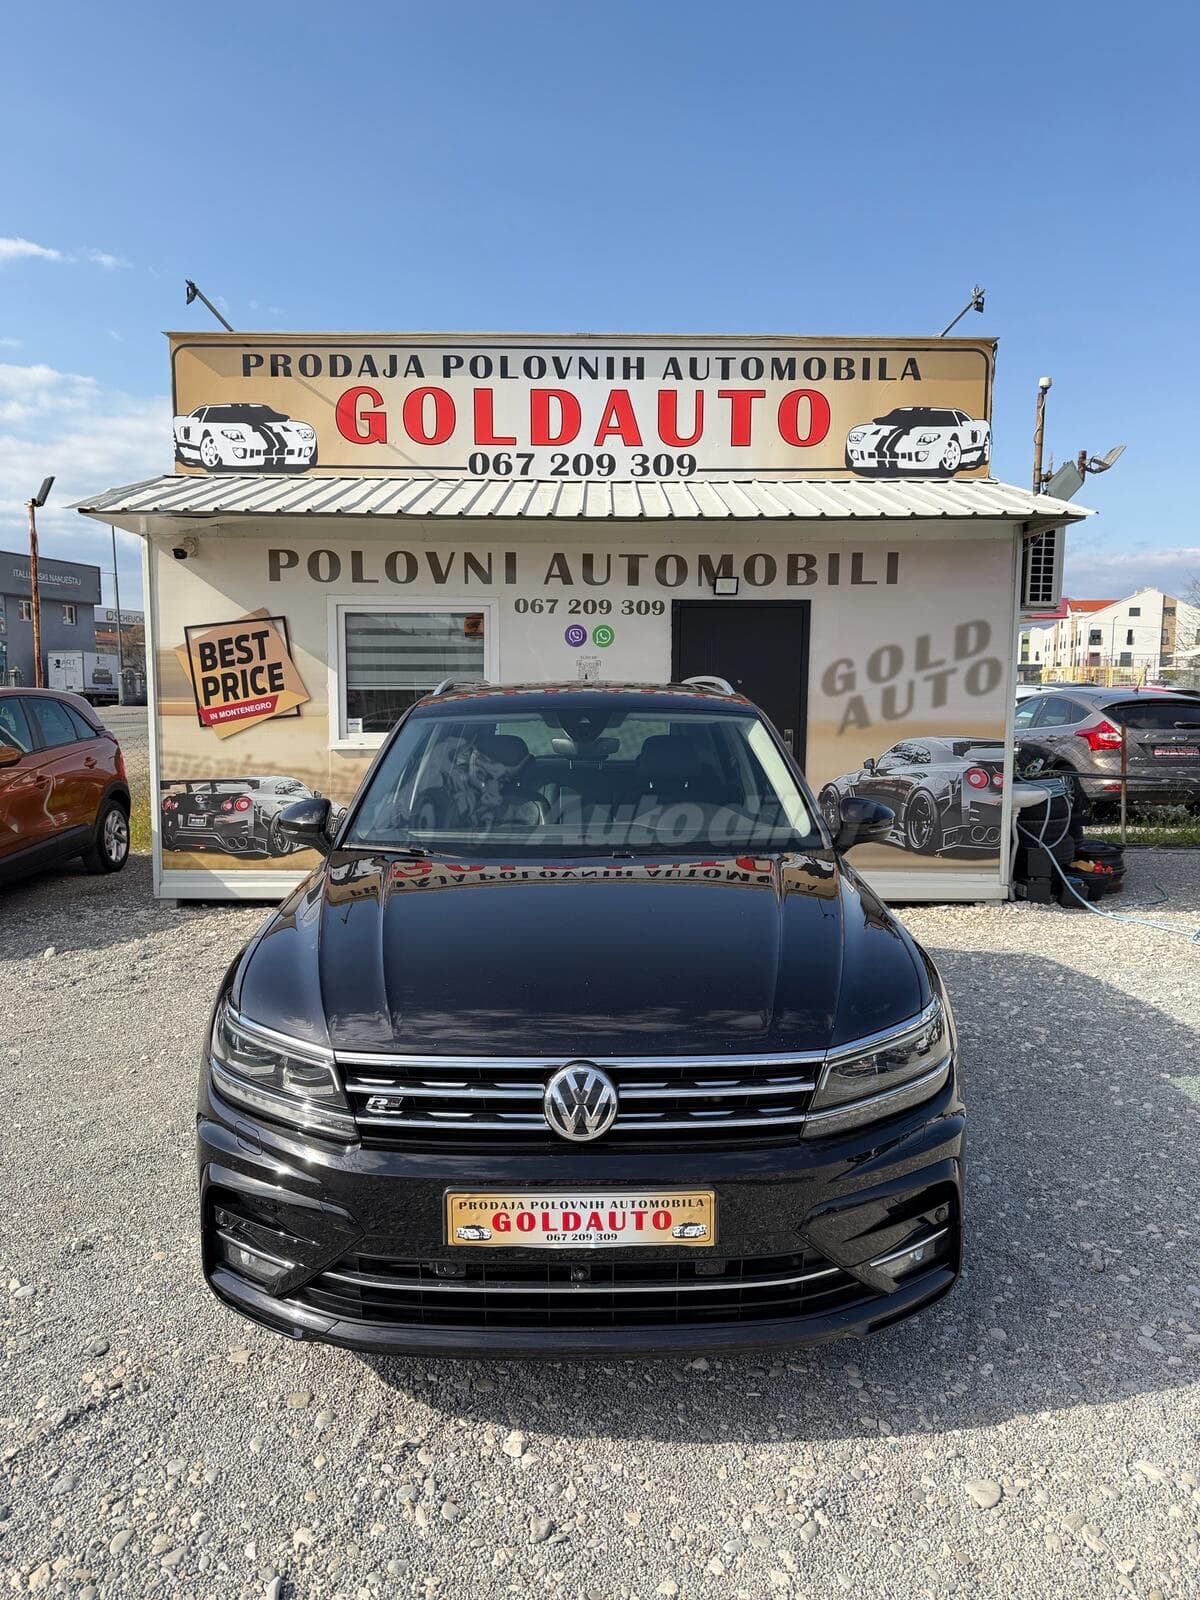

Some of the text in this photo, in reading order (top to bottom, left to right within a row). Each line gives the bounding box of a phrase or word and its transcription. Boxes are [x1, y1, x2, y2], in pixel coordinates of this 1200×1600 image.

[241, 353, 922, 382] PRODAJA POLOVNIH AUTOMOBILA
[335, 385, 832, 448] GOLDAUTO
[468, 452, 698, 478] 067 209 309
[267, 549, 900, 588] POLOVNI AUTOMOBILI
[513, 598, 666, 617] 067 209 309
[198, 630, 269, 672] BEST
[820, 618, 992, 699] GOLD
[201, 662, 285, 705] PRICE
[836, 655, 1004, 737] AUTO
[209, 702, 271, 720] IN MONTENEGRO
[458, 1198, 705, 1211] PRODAJA POLOVNIH AUTOMOBILA
[491, 1210, 673, 1233] GOLDAUTO
[546, 1232, 618, 1241] 067 209 309
